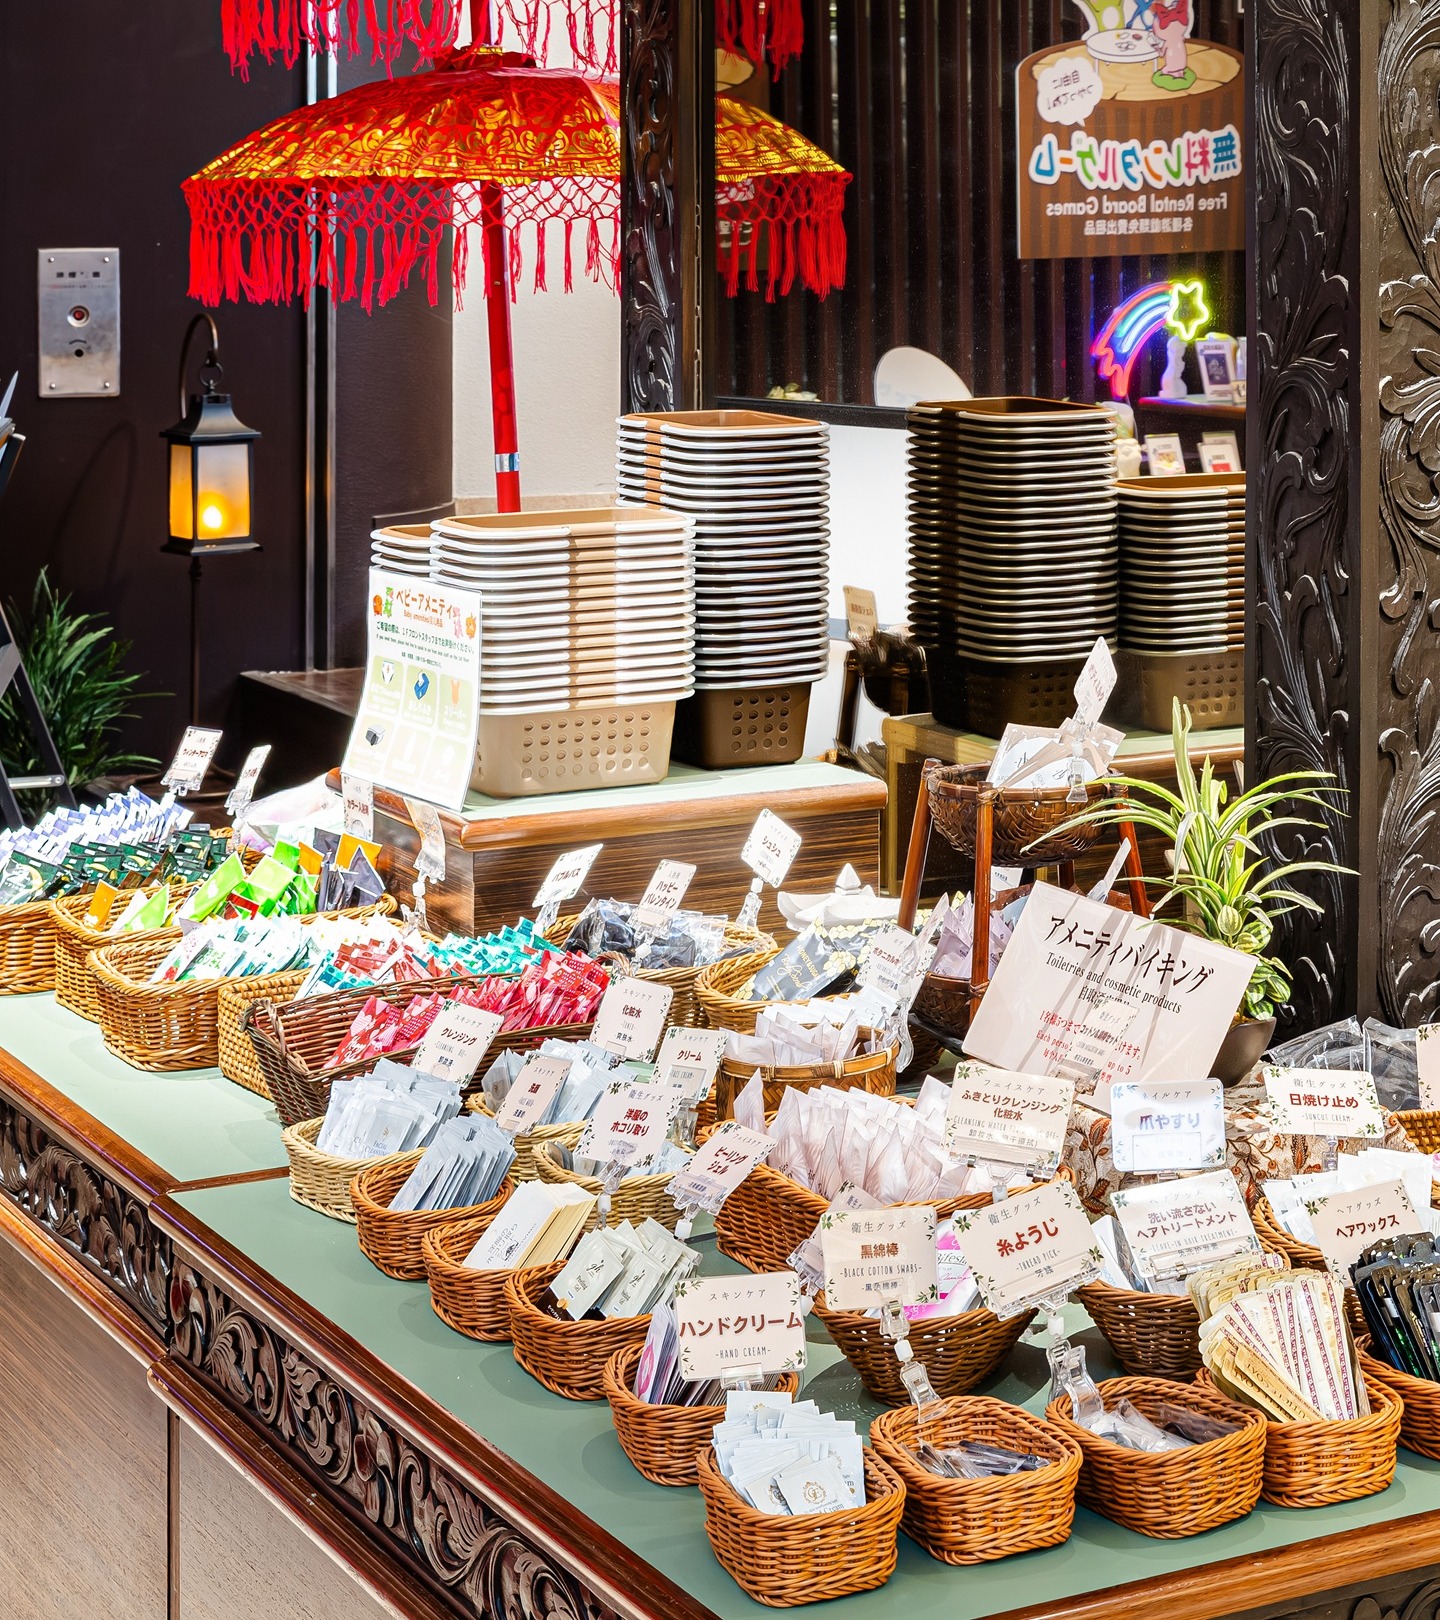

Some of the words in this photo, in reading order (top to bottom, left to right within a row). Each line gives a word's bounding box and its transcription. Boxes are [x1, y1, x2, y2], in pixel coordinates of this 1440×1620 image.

[761, 835, 782, 858] シュシュ
[1044, 915, 1216, 994] アメニティバイキング
[1045, 951, 1086, 979] Toiletries
[1087, 968, 1103, 984] and
[1104, 975, 1142, 1000] cosmetic
[1142, 991, 1183, 1014] products
[622, 988, 652, 1001] スキンケア
[622, 1004, 642, 1019] 化粧水
[440, 1026, 479, 1046] クレンジング
[682, 1034, 709, 1043] スキンケア
[676, 1049, 702, 1062] クリーム
[1125, 1065, 1132, 1076] 5
[983, 1078, 1046, 1096] フェイスケア
[1293, 1078, 1348, 1090] 衛生グッズ
[628, 1088, 665, 1103] 衛生グッズ
[961, 1089, 1063, 1115] ふきとりクレンジング
[1289, 1093, 1359, 1110] 日焼け止め
[624, 1107, 649, 1122] 洋服の
[992, 1107, 1024, 1122] 化粧水
[1138, 1113, 1201, 1131] 爪やすり
[610, 1119, 650, 1137] ホコリ取り
[713, 1145, 749, 1166] ピーリング
[706, 1160, 729, 1176] ジェル
[987, 1196, 1043, 1226] 衛生グッズ
[1147, 1201, 1217, 1225] 洗い流さない
[1336, 1197, 1383, 1215] ヘアグッズ
[850, 1220, 907, 1235] 衛生グッズ
[1136, 1211, 1238, 1241] ヘアトリートメント
[1335, 1214, 1401, 1239] ヘアワックス
[995, 1216, 1061, 1259] 糸ようじ
[860, 1242, 899, 1260] 黒綿棒
[868, 1266, 894, 1277] COTTON
[708, 1289, 767, 1302] スキンケア
[679, 1312, 803, 1338] ハンドクリーム
